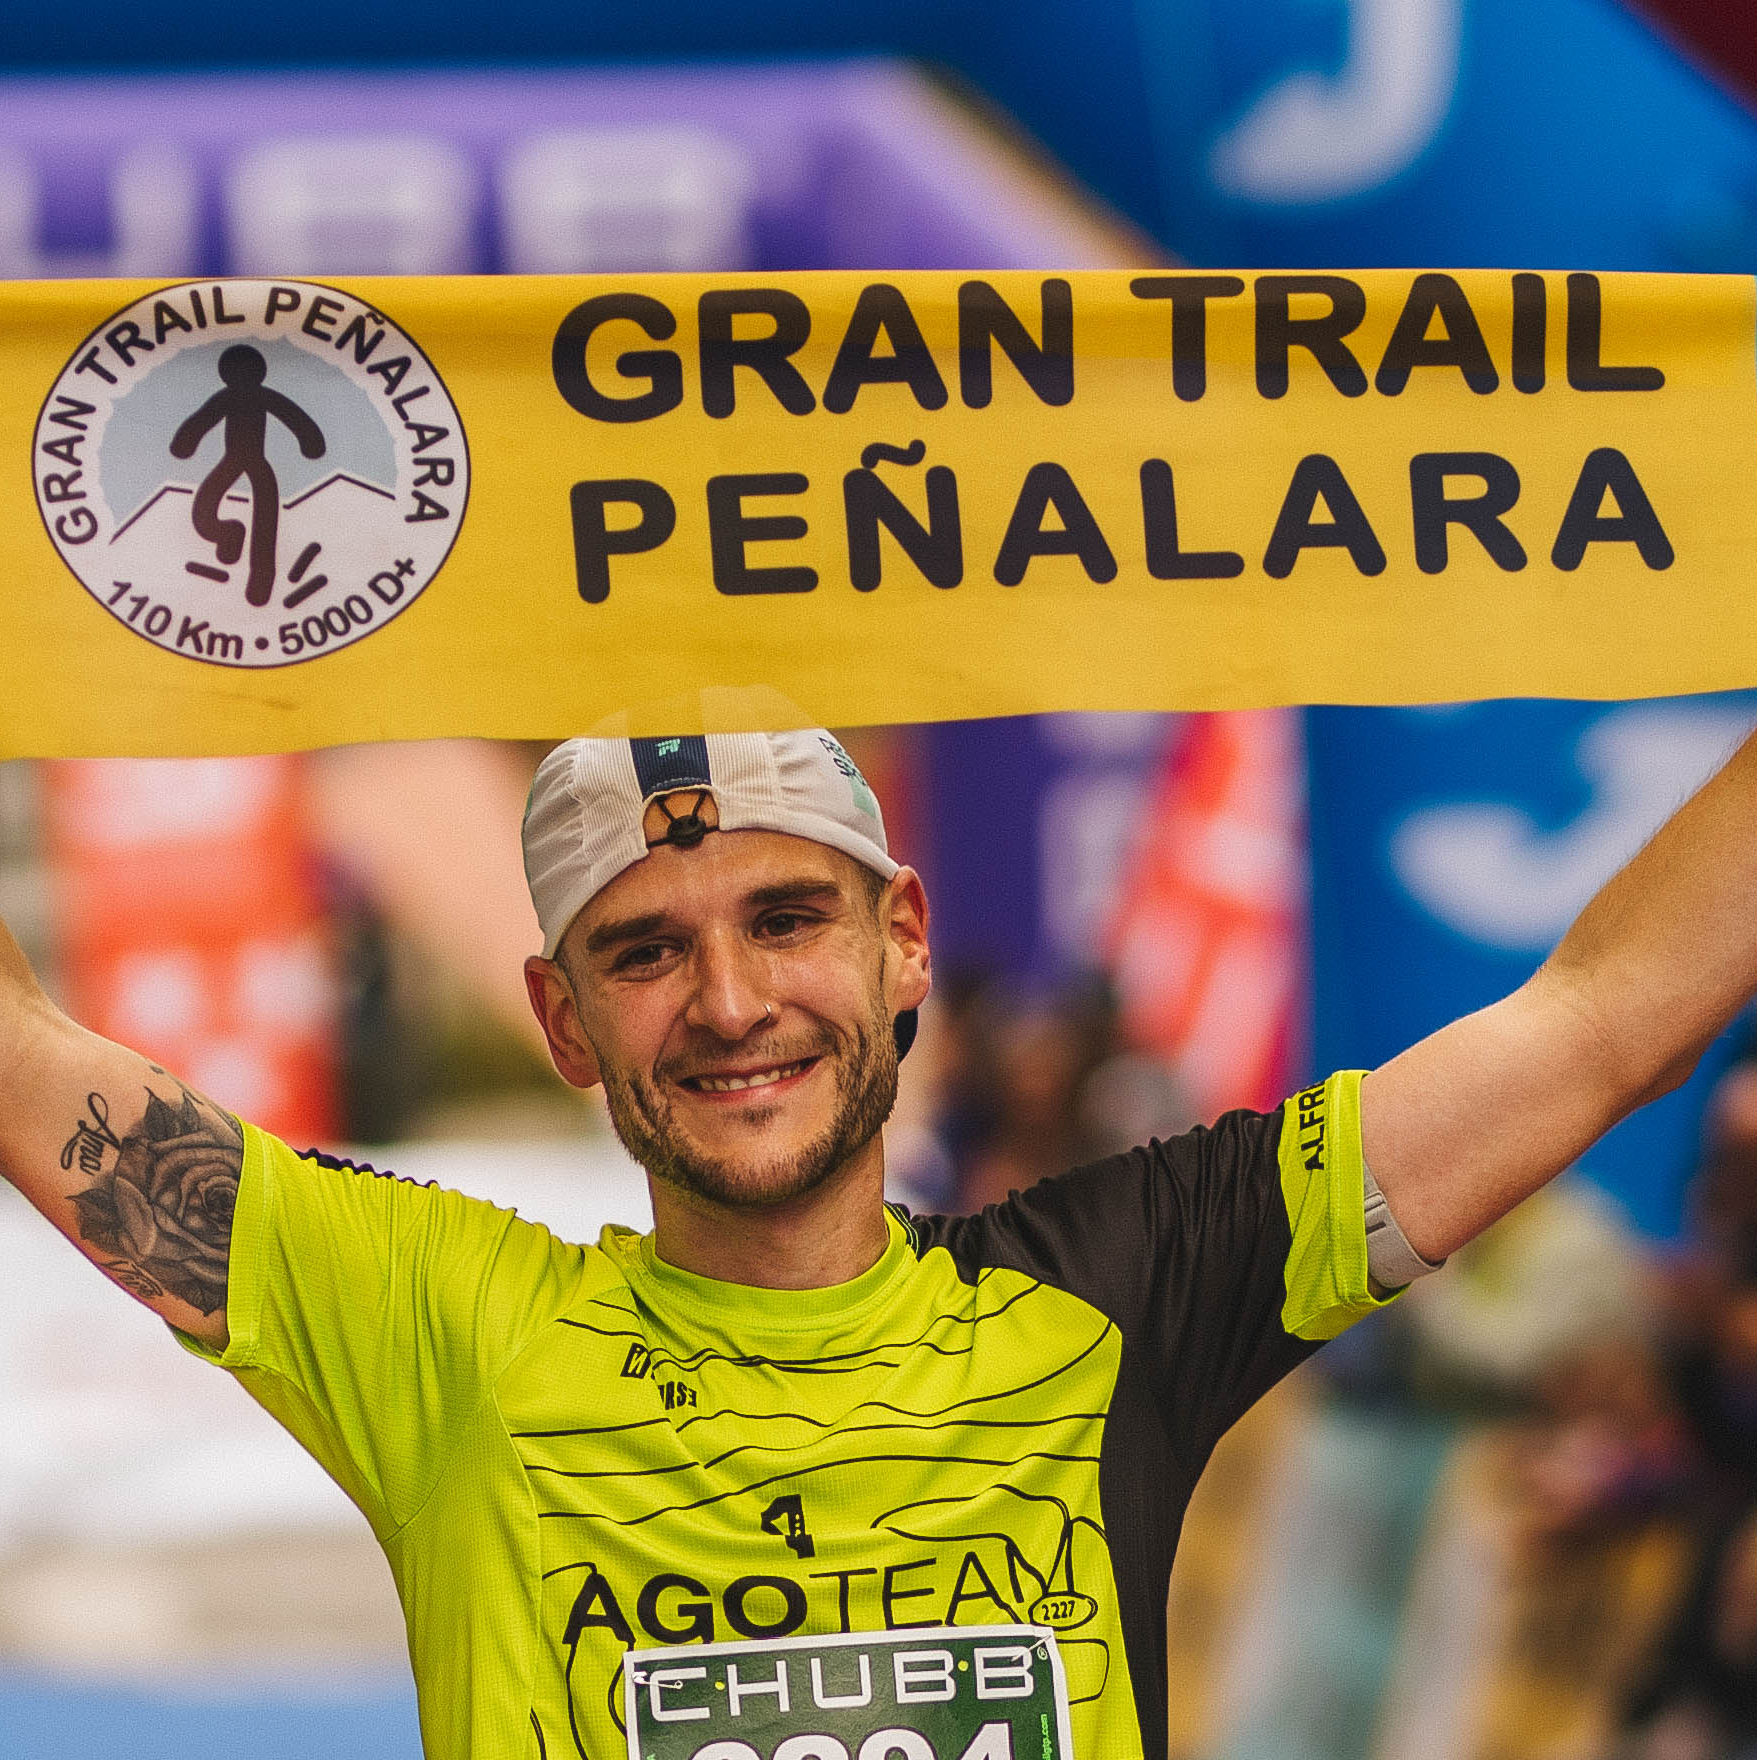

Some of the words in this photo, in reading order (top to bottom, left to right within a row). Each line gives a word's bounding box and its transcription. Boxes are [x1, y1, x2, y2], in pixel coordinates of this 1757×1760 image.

[74, 283, 248, 388] TRAIL
[258, 284, 455, 528] PEÑALARA
[550, 277, 1076, 424] GRAN
[1128, 270, 1666, 402] TRAIL
[53, 394, 102, 548] GRAN
[568, 436, 1678, 606] PEÑALARA
[104, 578, 177, 646] 110
[174, 612, 245, 662] Km
[278, 592, 376, 660] 5000
[371, 553, 423, 611] D+
[647, 1646, 1036, 1722] CHUBB
